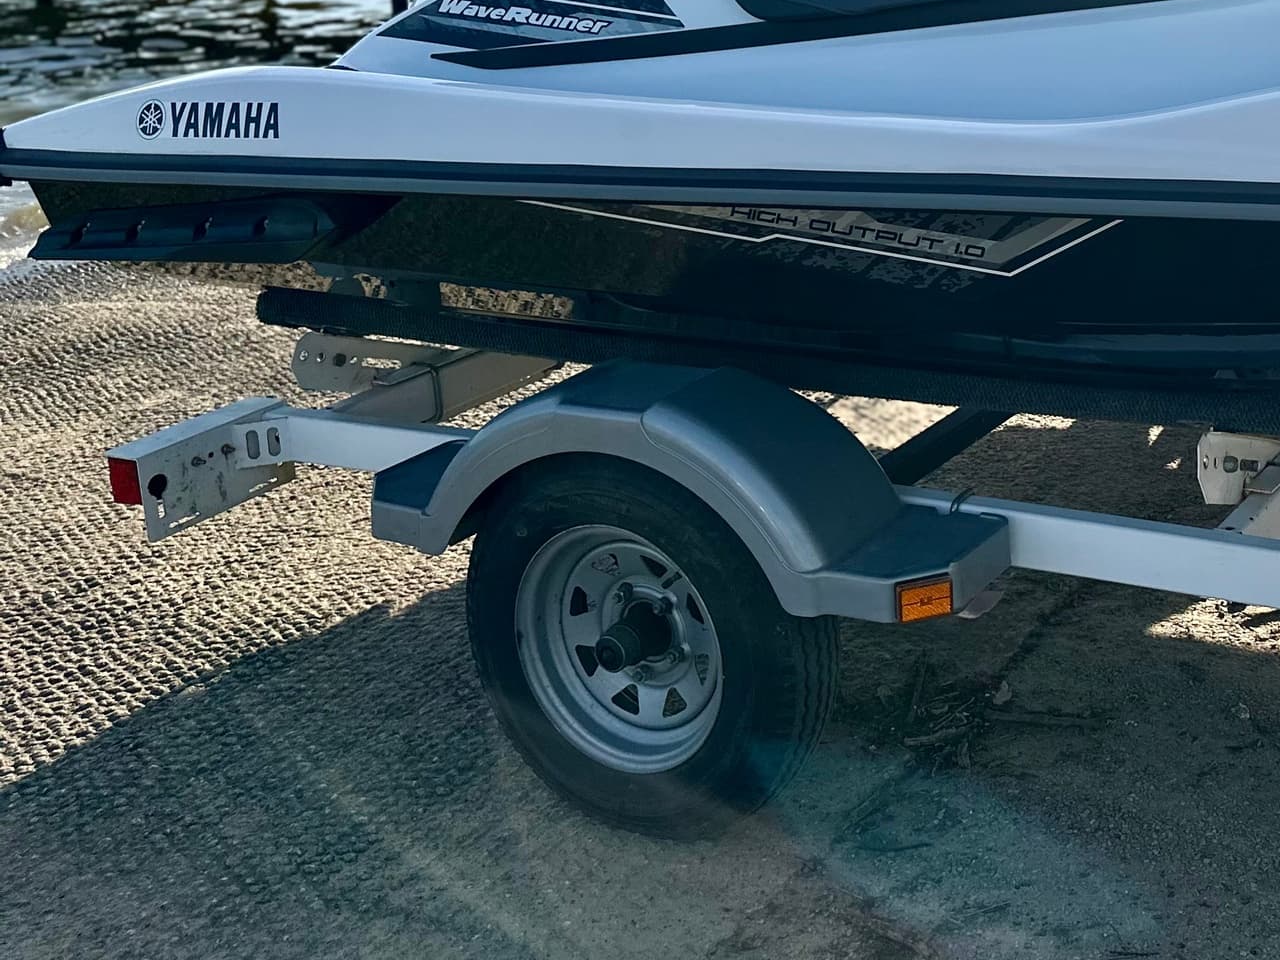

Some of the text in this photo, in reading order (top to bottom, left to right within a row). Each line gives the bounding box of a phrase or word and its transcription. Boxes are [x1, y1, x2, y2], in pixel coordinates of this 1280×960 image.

[170, 101, 280, 139] YAMAHA
[730, 206, 986, 258] HIGH OUTPUT 1.0
